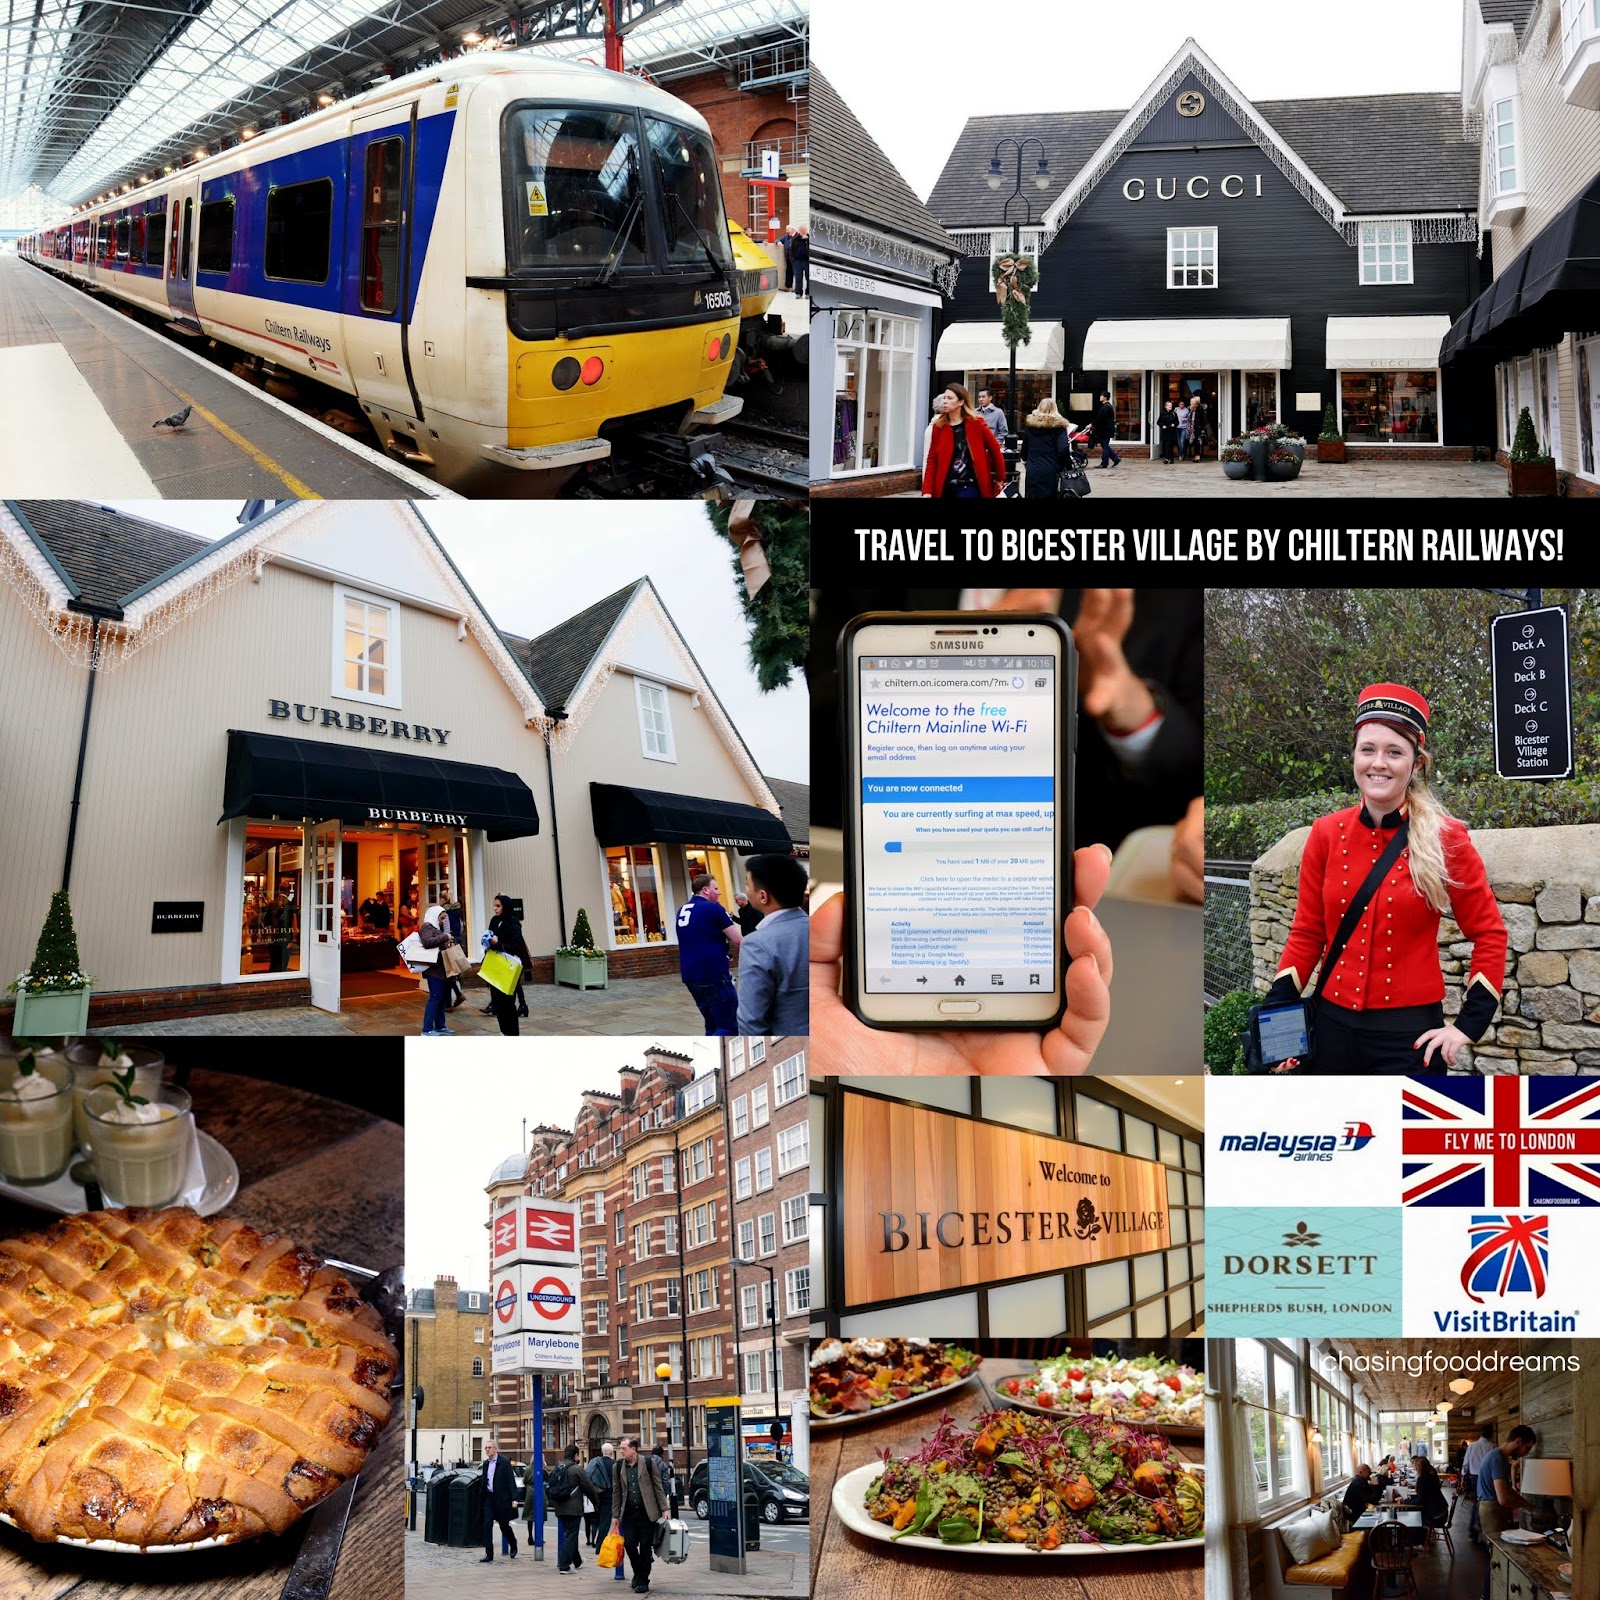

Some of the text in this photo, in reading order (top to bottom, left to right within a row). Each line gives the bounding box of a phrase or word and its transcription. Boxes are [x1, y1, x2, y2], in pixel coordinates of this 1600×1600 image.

[767, 154, 772, 173] 1
[1122, 174, 1263, 201] GUCCI
[816, 268, 875, 292] FURSTENBERG
[704, 290, 732, 310] 165015
[264, 318, 331, 353] Chiltern Railways
[1165, 361, 1202, 369] GUCCI
[1370, 359, 1410, 368] GUCCI
[930, 640, 984, 650] SAMSUNG
[1512, 637, 1546, 652] Deck A
[1026, 659, 1050, 668] 10:16
[1514, 669, 1546, 683] Deck B
[866, 701, 1007, 717] Welcome to the free
[1514, 701, 1548, 715] Deck C
[268, 698, 451, 745] BURBERRY
[867, 719, 1027, 734] Chiltern Mainline Wi-Fi
[1514, 735, 1550, 746] Bicester
[867, 744, 895, 753] Register
[935, 744, 947, 752] log
[959, 744, 987, 752] anytime
[989, 744, 1008, 752] using
[1517, 746, 1548, 757] Village
[1516, 757, 1549, 768] Station
[867, 784, 884, 792] You
[919, 783, 963, 792] connected
[367, 807, 468, 826] BURBERRY
[883, 810, 899, 818] You
[916, 809, 953, 820] currently
[954, 809, 984, 819] surfing
[1015, 809, 1043, 819] speed,
[711, 836, 754, 848] BURBERRY
[678, 903, 695, 927] 5
[1219, 1131, 1337, 1158] malaysia
[1293, 1152, 1333, 1162] airlines
[1039, 1160, 1111, 1186] Welcome to
[879, 1211, 1164, 1253] BICESTER VILLAGE
[1224, 1255, 1378, 1275] DORSETT
[529, 1293, 574, 1303] UNDERGROUND
[1207, 1303, 1392, 1315] SHEPHERDS BUSH, LONDON
[493, 1339, 521, 1353] Marylebone
[528, 1337, 580, 1349] Marylebone
